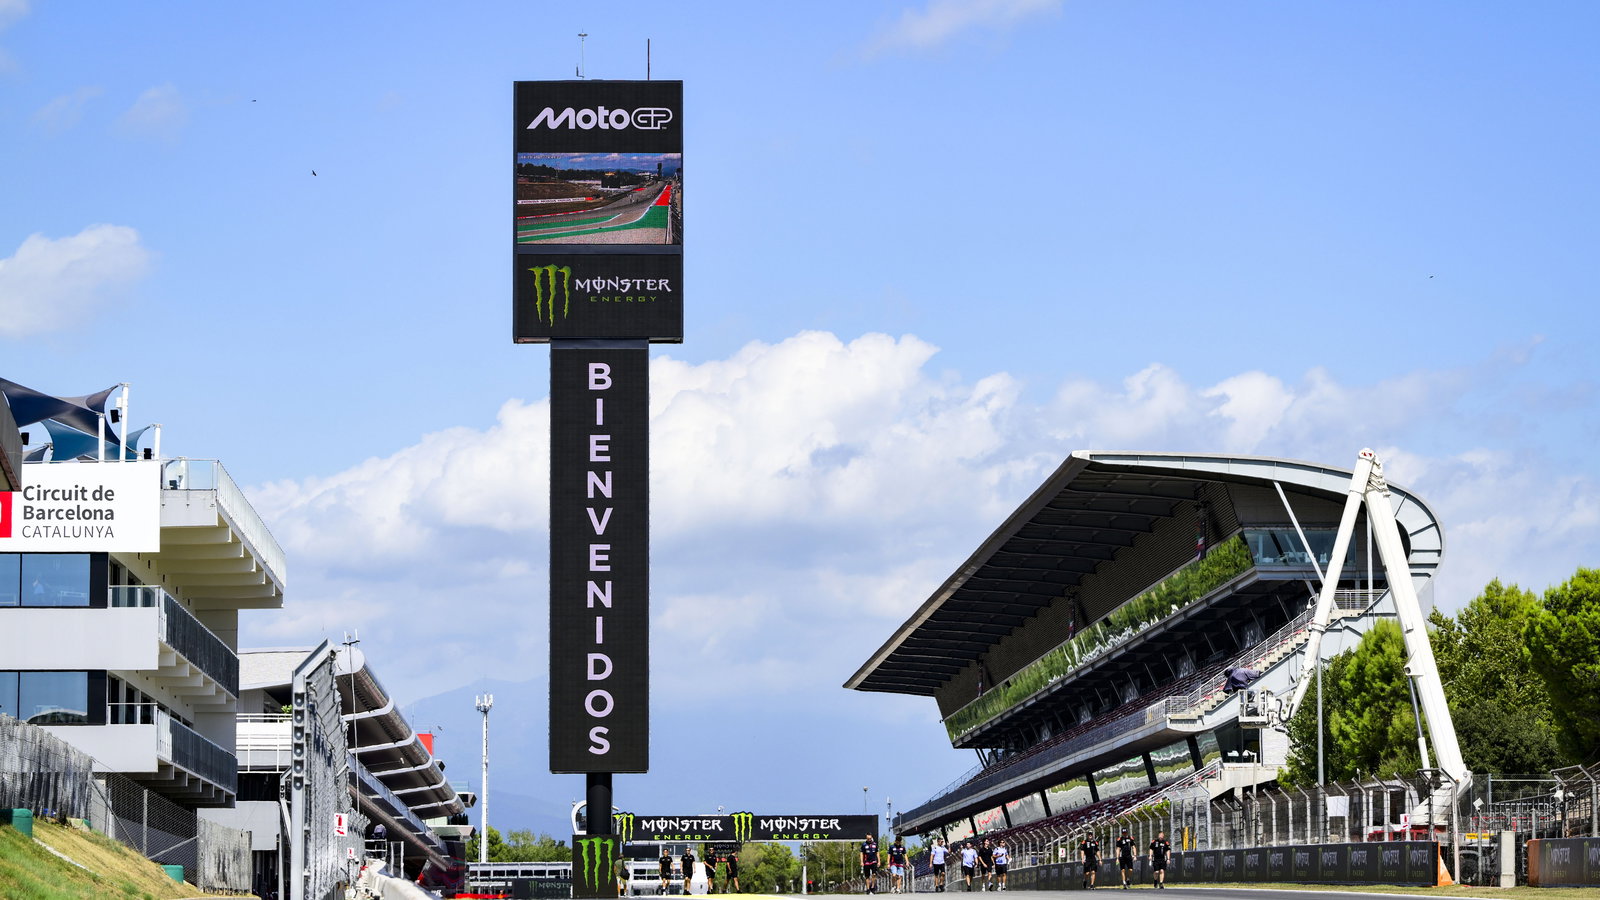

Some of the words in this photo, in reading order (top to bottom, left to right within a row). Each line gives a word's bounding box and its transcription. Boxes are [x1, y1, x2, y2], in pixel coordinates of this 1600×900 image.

[526, 106, 673, 130] MotoGP
[574, 275, 672, 293] MONSTER
[590, 295, 657, 303] ENERGY
[22, 485, 88, 502] Circuit
[91, 485, 115, 502] de
[22, 505, 115, 521] Barcelona
[21, 525, 114, 539] CATALUNYA
[584, 362, 615, 755] BIENVENIDOS
[641, 816, 724, 833] MONSTER
[759, 816, 842, 833] MONSTER
